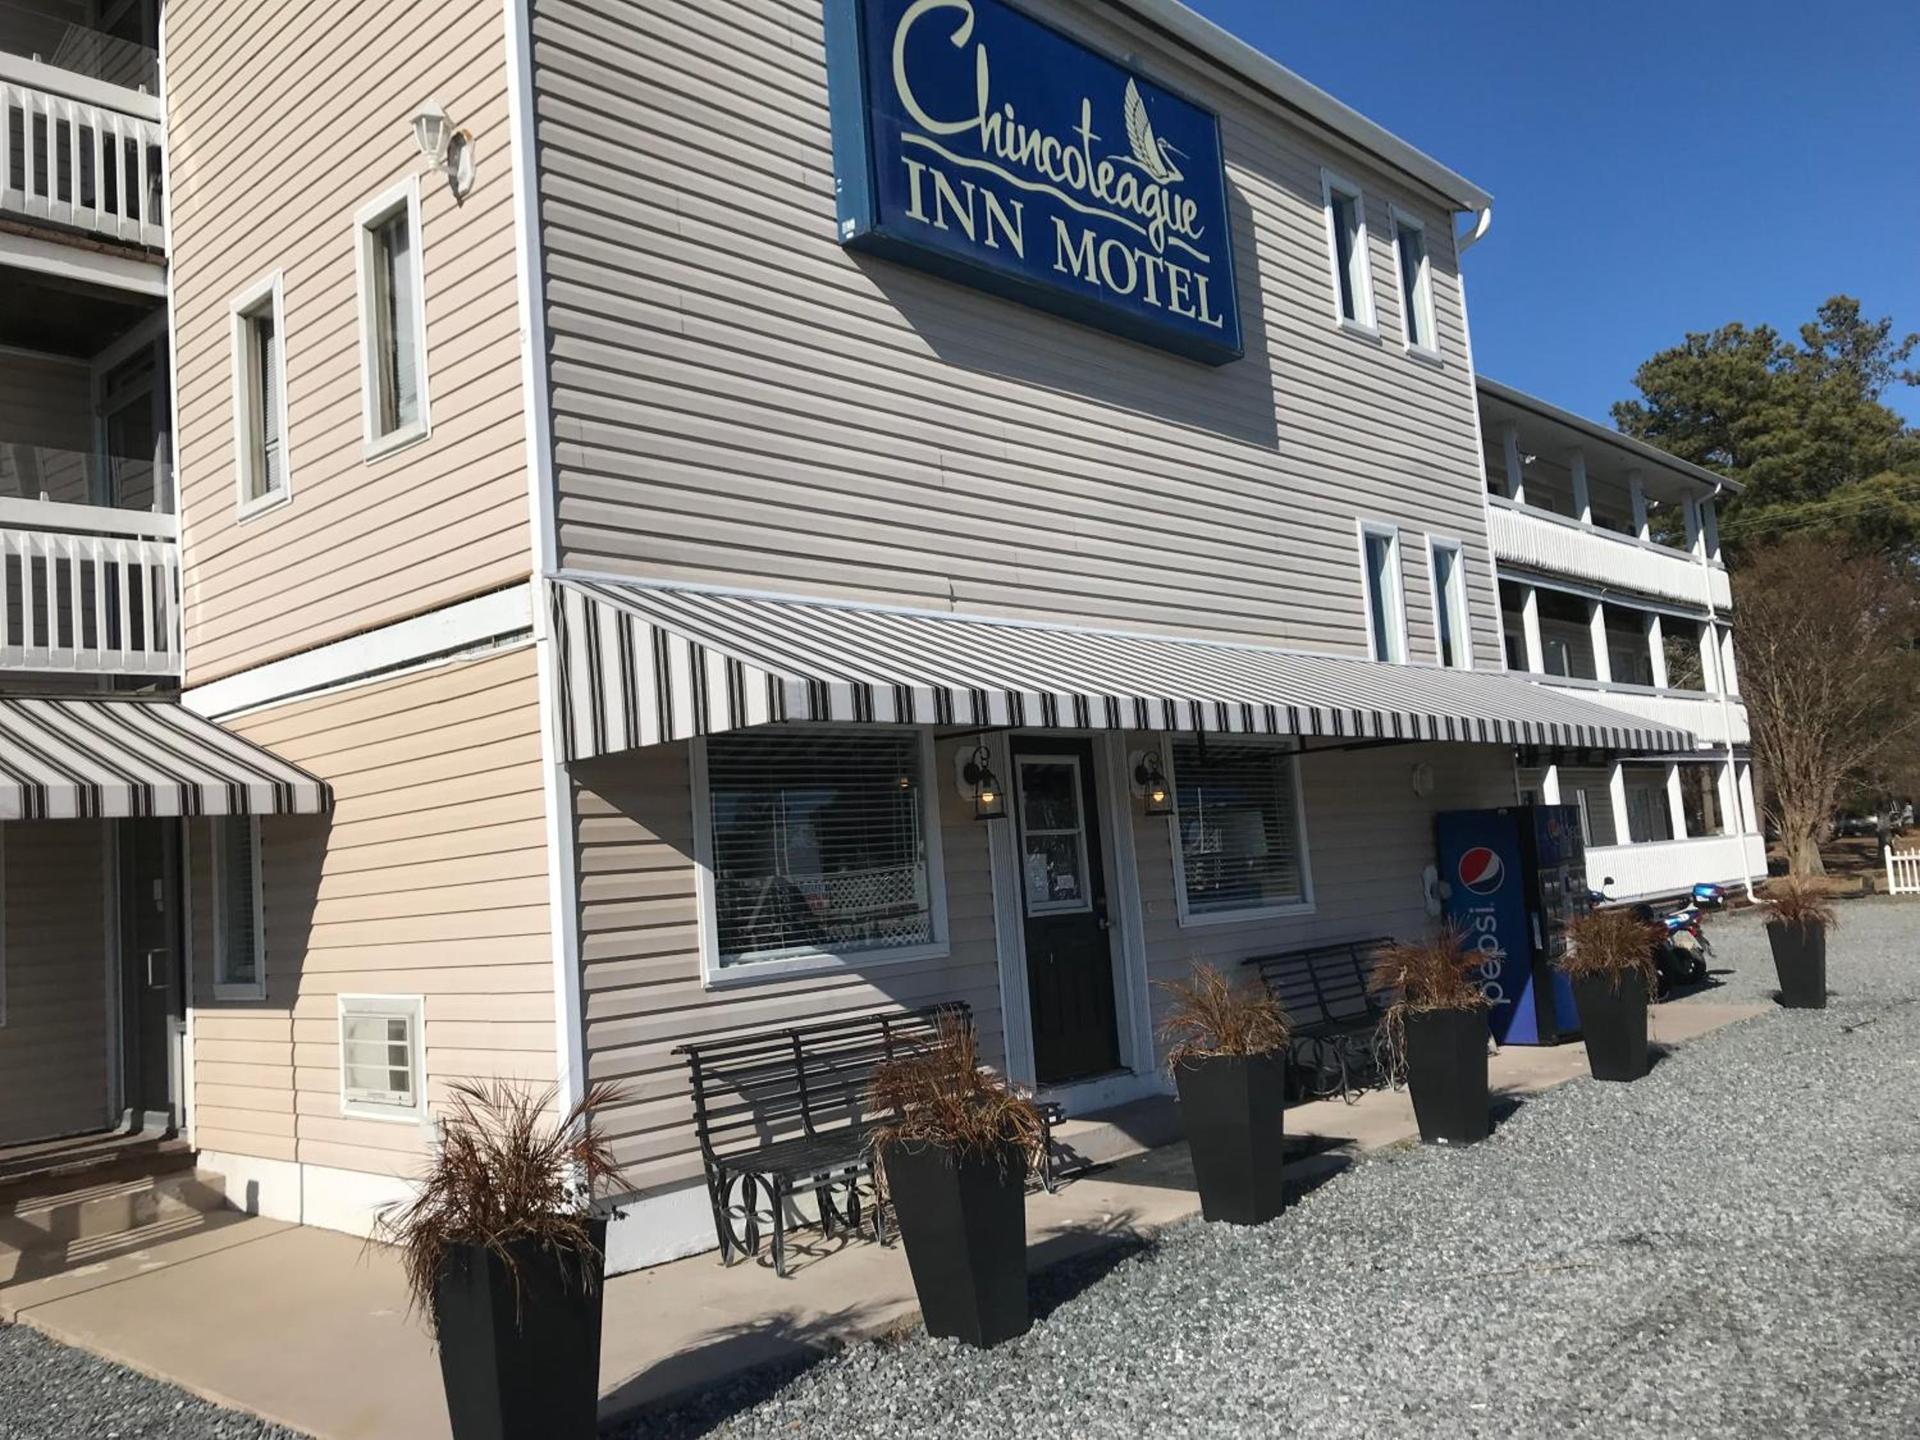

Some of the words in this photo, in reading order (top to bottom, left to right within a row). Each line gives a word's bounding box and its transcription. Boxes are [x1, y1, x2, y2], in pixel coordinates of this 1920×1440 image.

[893, 0, 1205, 253] Chincoteague
[901, 156, 1025, 259] INN
[1050, 215, 1223, 328] MOTEL
[1468, 906, 1511, 1004] pepsi
